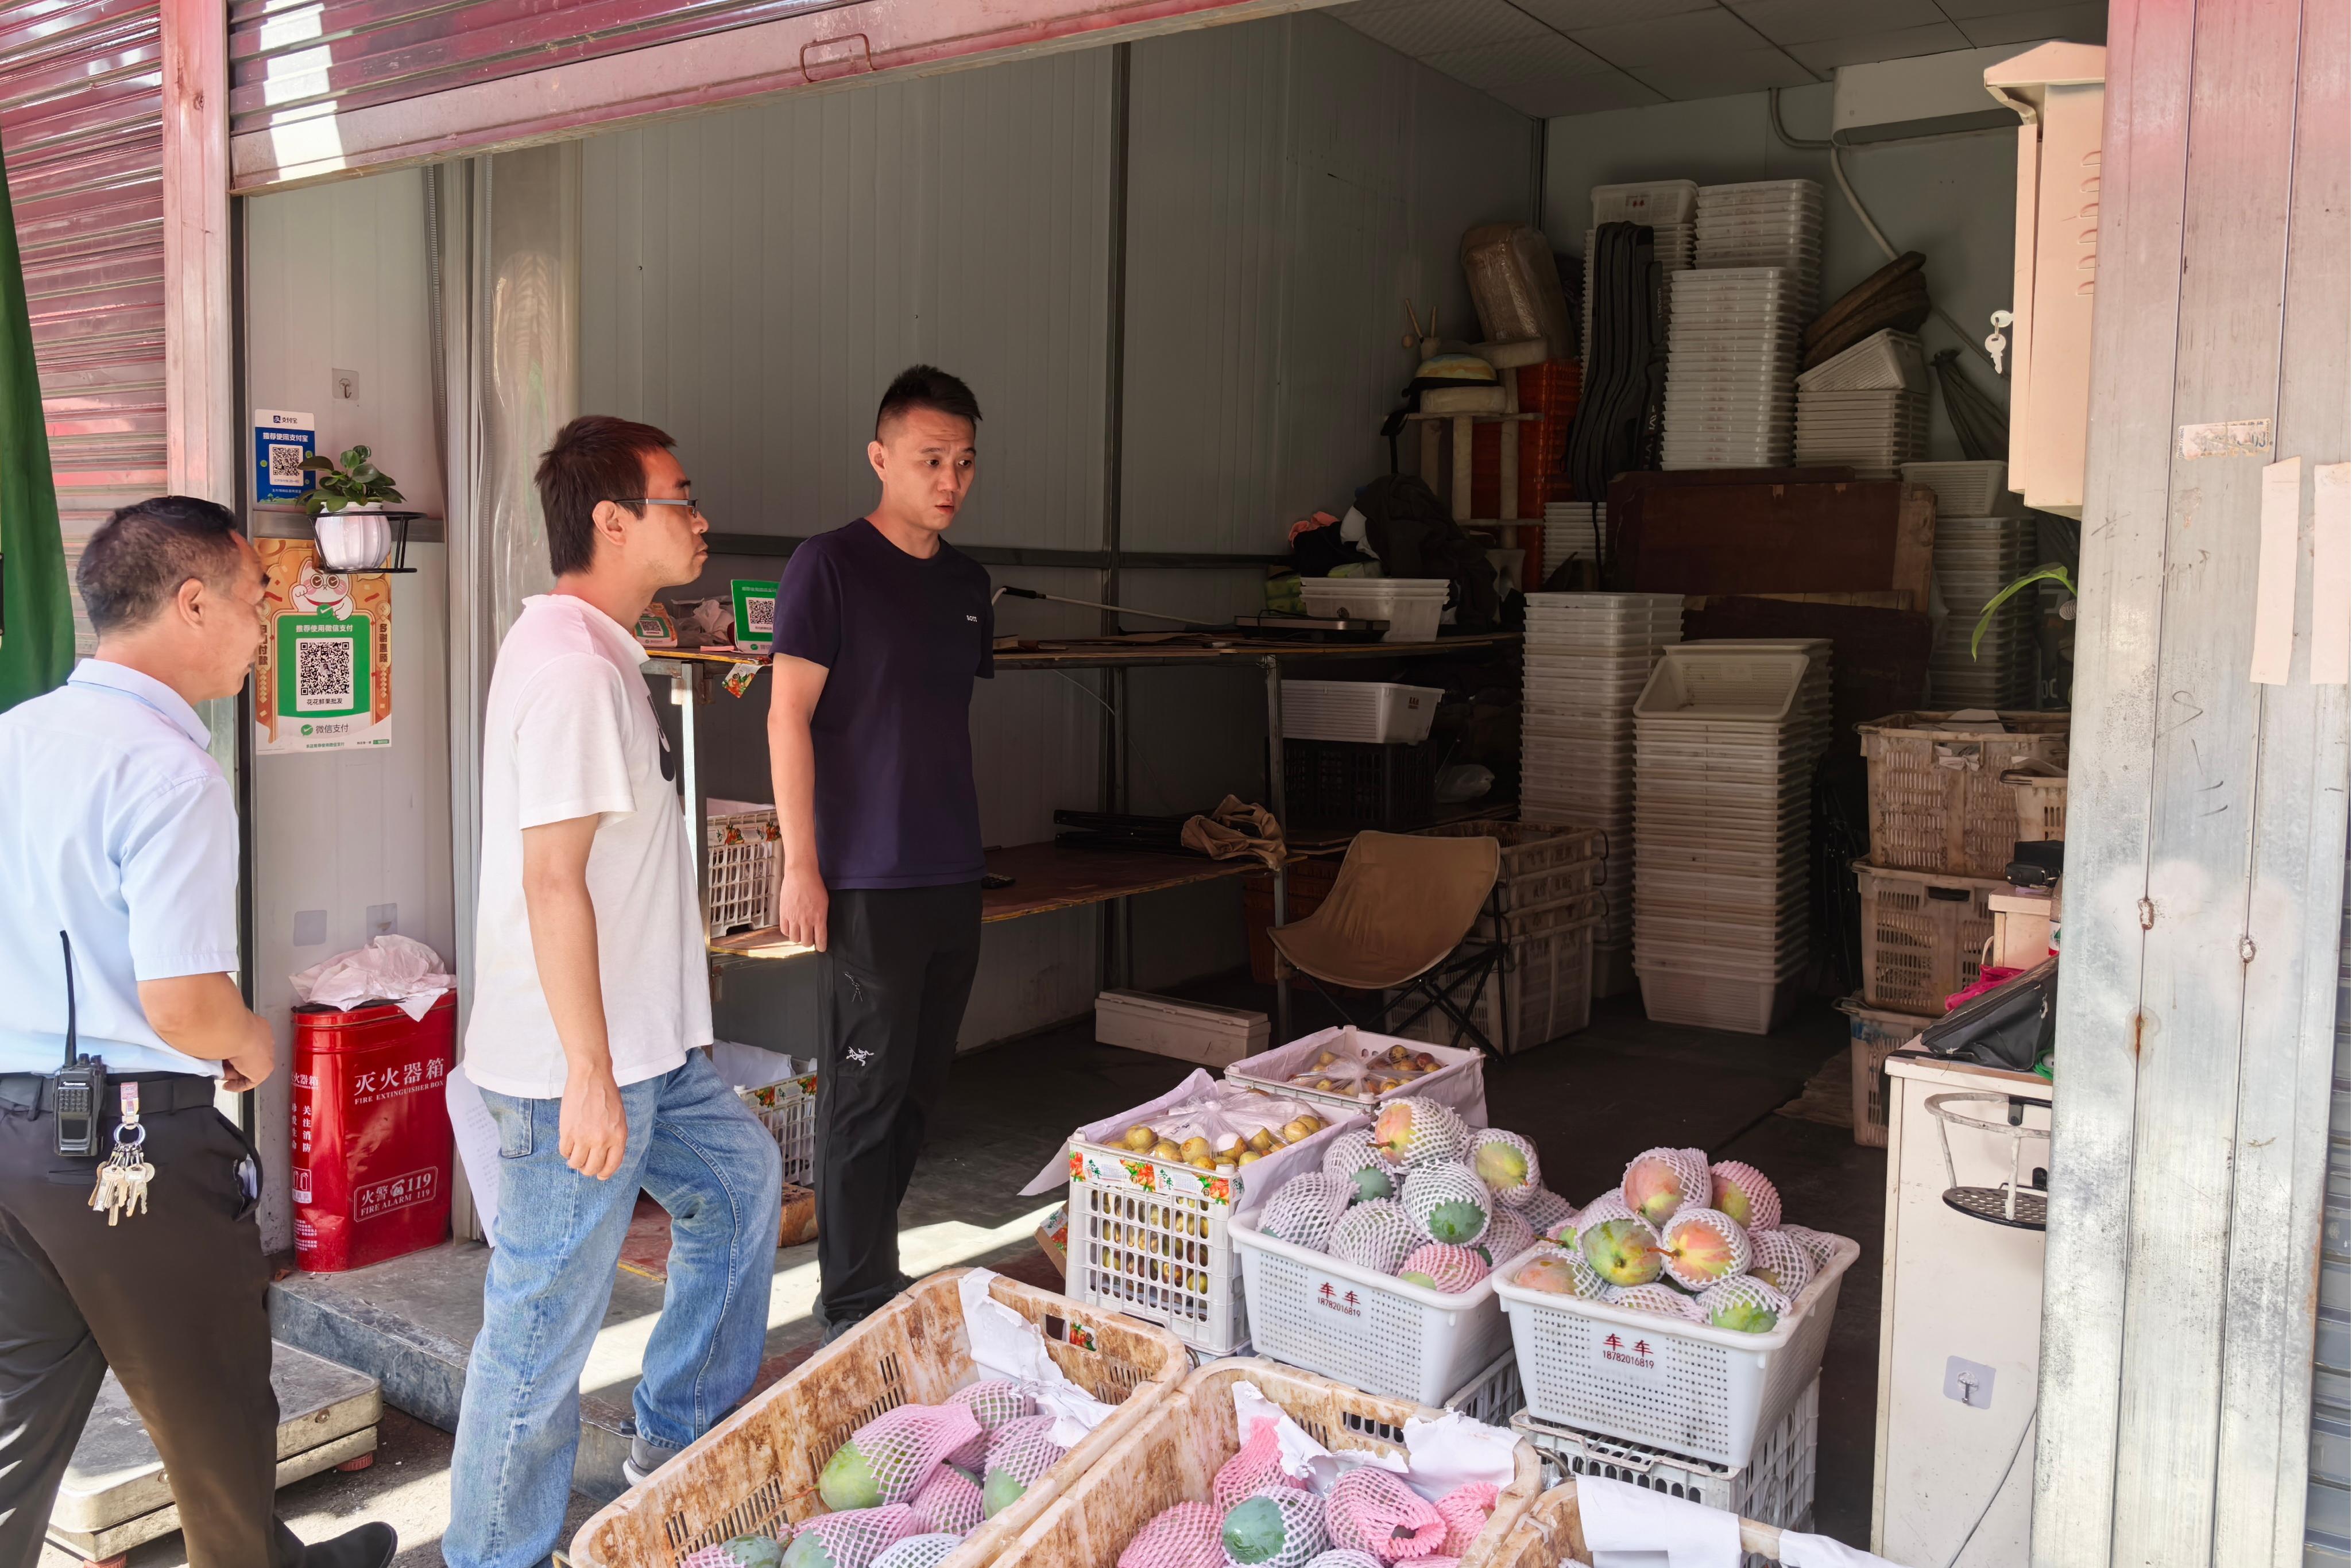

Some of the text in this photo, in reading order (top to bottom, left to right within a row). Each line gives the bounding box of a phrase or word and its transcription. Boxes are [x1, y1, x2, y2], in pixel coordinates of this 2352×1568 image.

[263, 432, 308, 442] 推荐使用支付宝
[296, 625, 353, 633] 推荐使用微信支付
[379, 623, 388, 663] 多谢惠顾
[315, 723, 349, 734] 微信支付
[291, 1073, 319, 1086] 火器箱
[354, 1057, 444, 1096] 灭火器箱
[354, 1079, 444, 1105] FIRE EXTINGUISHER BOX
[303, 1105, 312, 1153] 关注消防
[361, 1173, 432, 1207] 火警 119
[361, 1189, 431, 1216] FIRE ALARM 119
[1603, 1350, 1655, 1369] 18782016819
